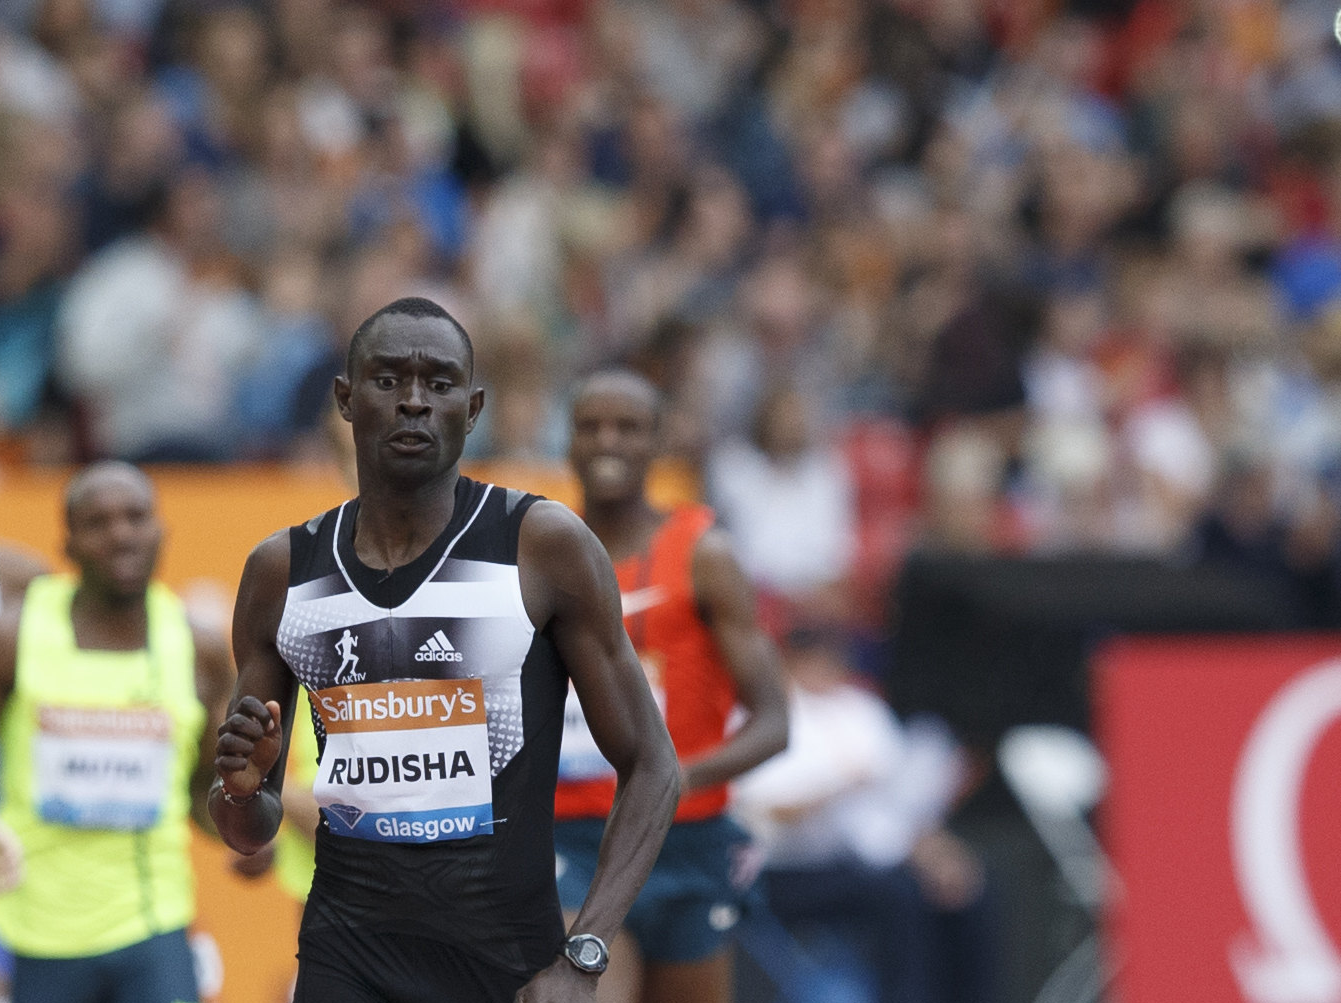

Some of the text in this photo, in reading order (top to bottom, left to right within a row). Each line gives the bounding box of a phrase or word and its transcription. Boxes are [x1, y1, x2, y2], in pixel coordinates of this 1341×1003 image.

[415, 650, 463, 662] adidas
[321, 687, 476, 722] Sainsbury's
[328, 751, 475, 785] RUDISHA
[375, 816, 475, 840] Glasgow
